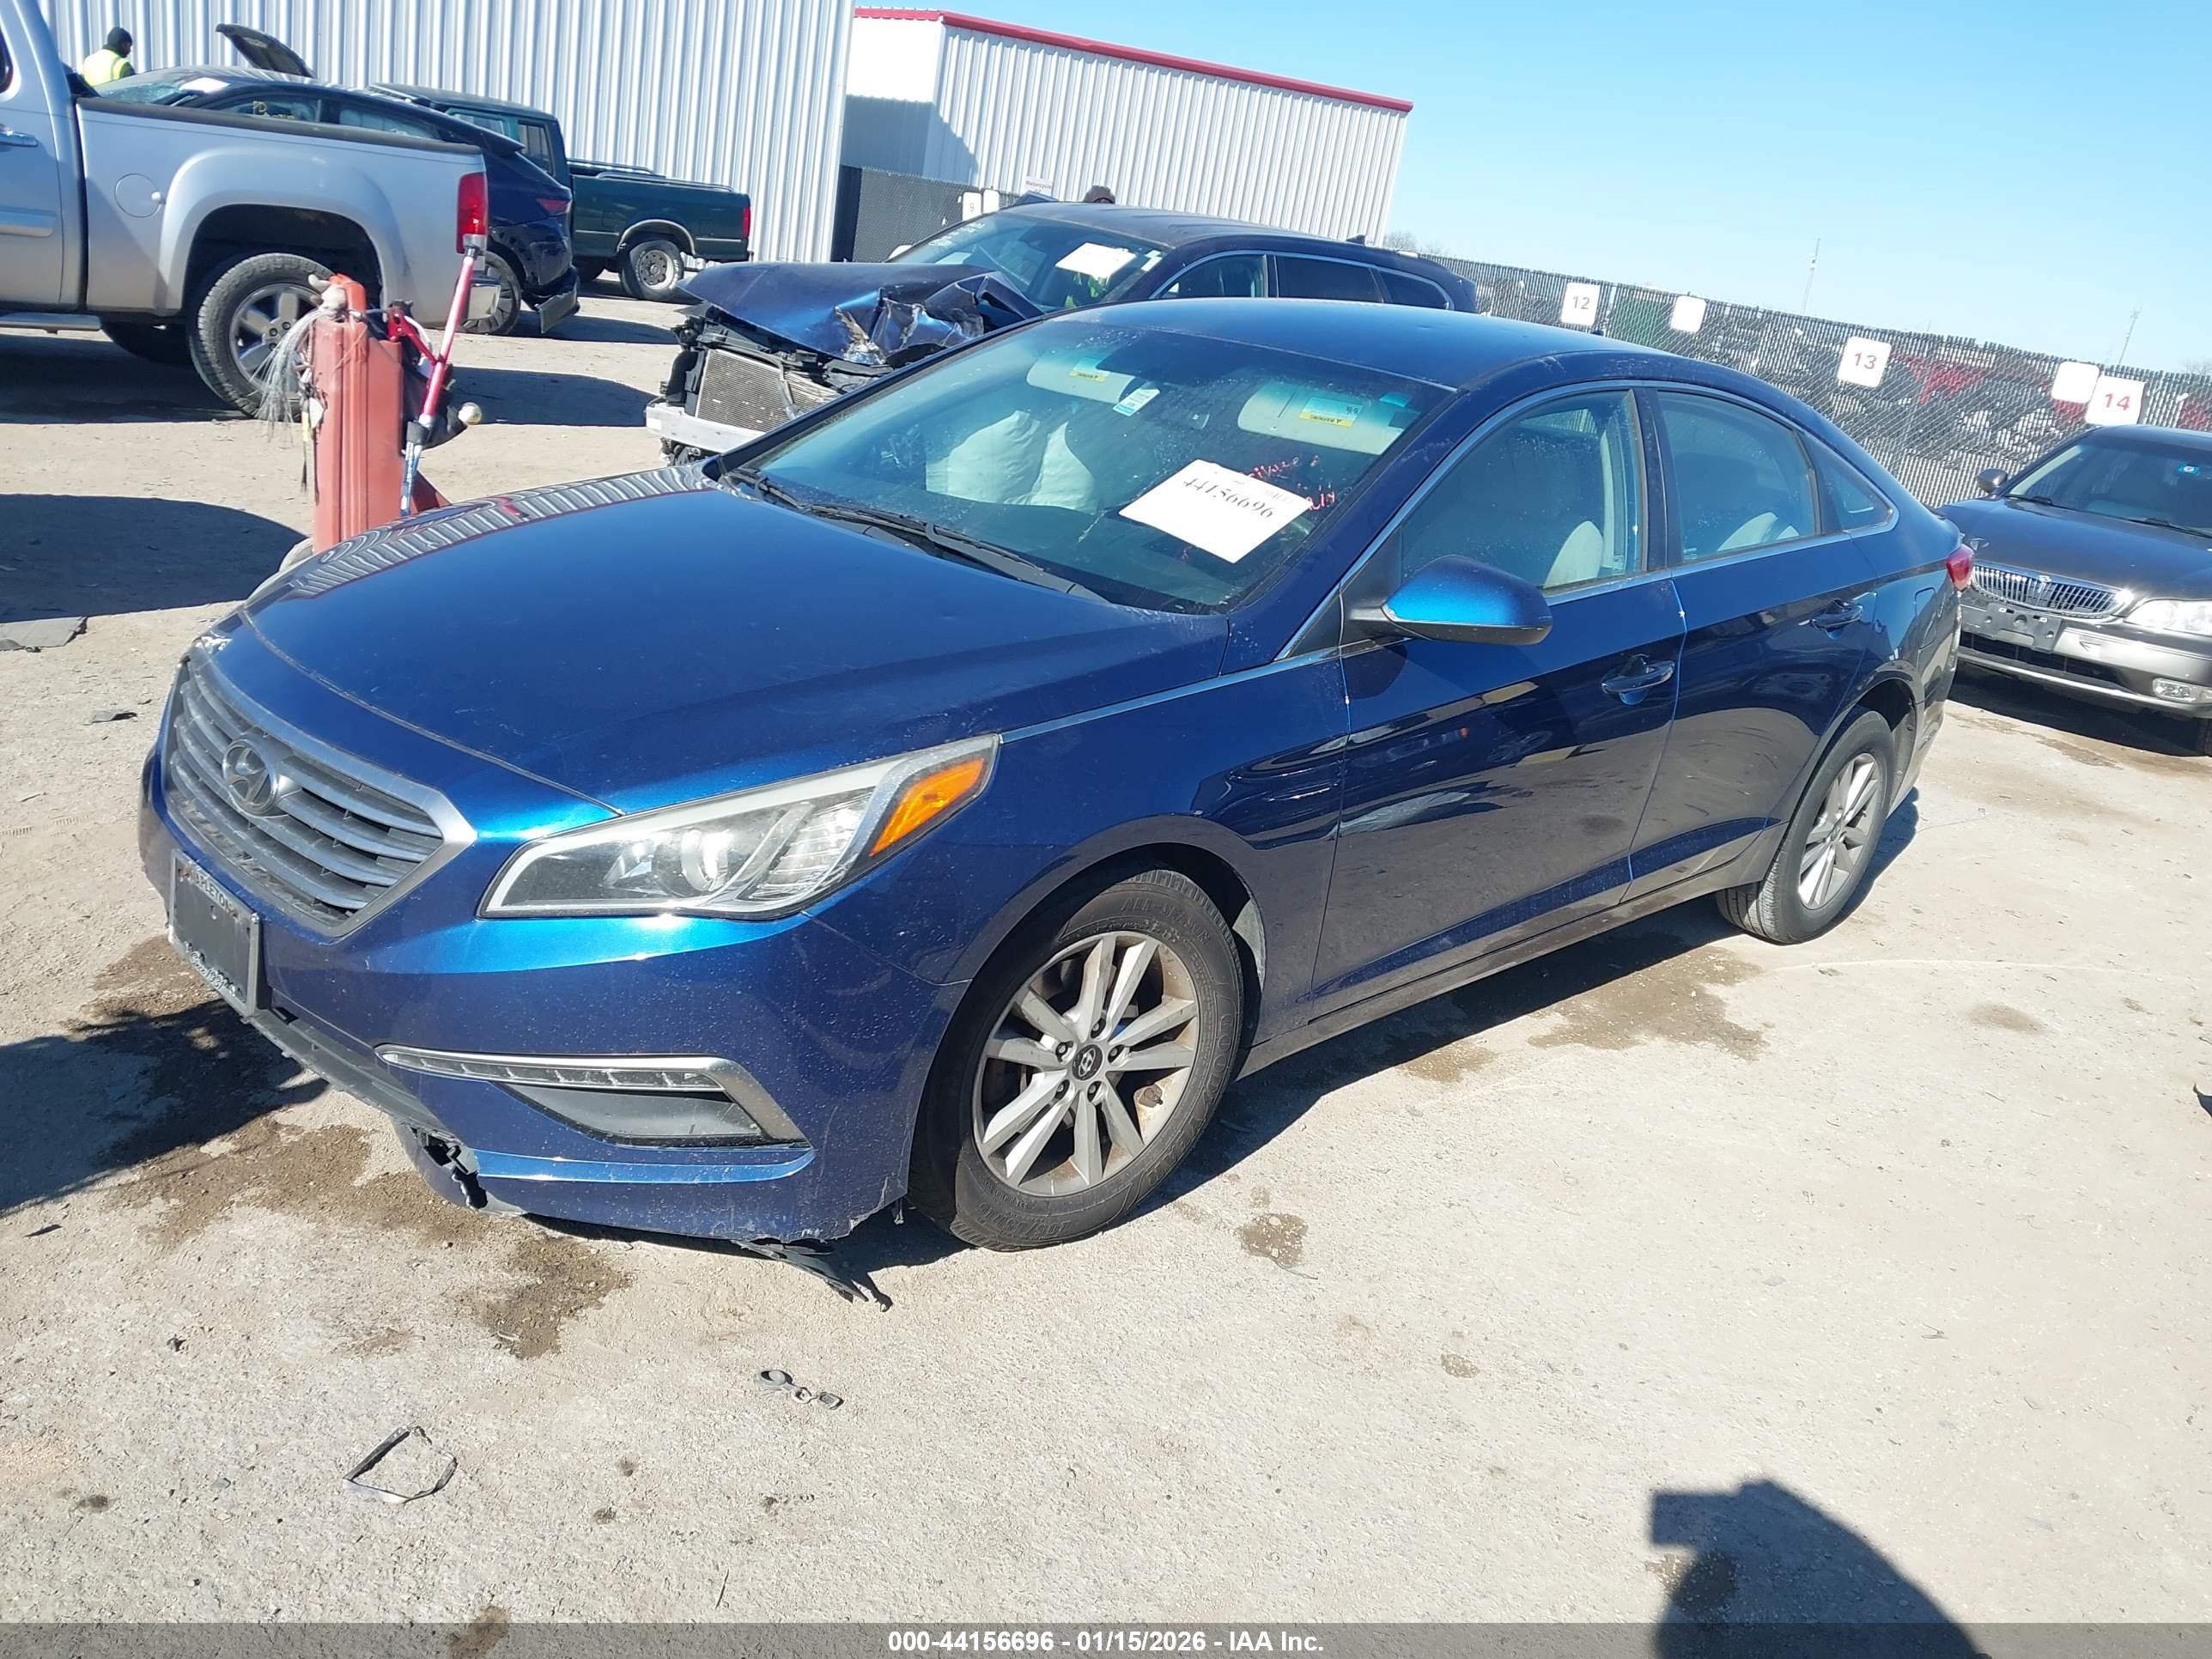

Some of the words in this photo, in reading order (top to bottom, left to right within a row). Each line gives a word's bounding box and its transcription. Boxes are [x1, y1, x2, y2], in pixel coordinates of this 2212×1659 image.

[969, 202, 975, 212] 9
[1573, 295, 1589, 310] 12
[1855, 352, 1877, 369] 13
[2105, 393, 2131, 411] 14
[1183, 477, 1274, 519] 44156696
